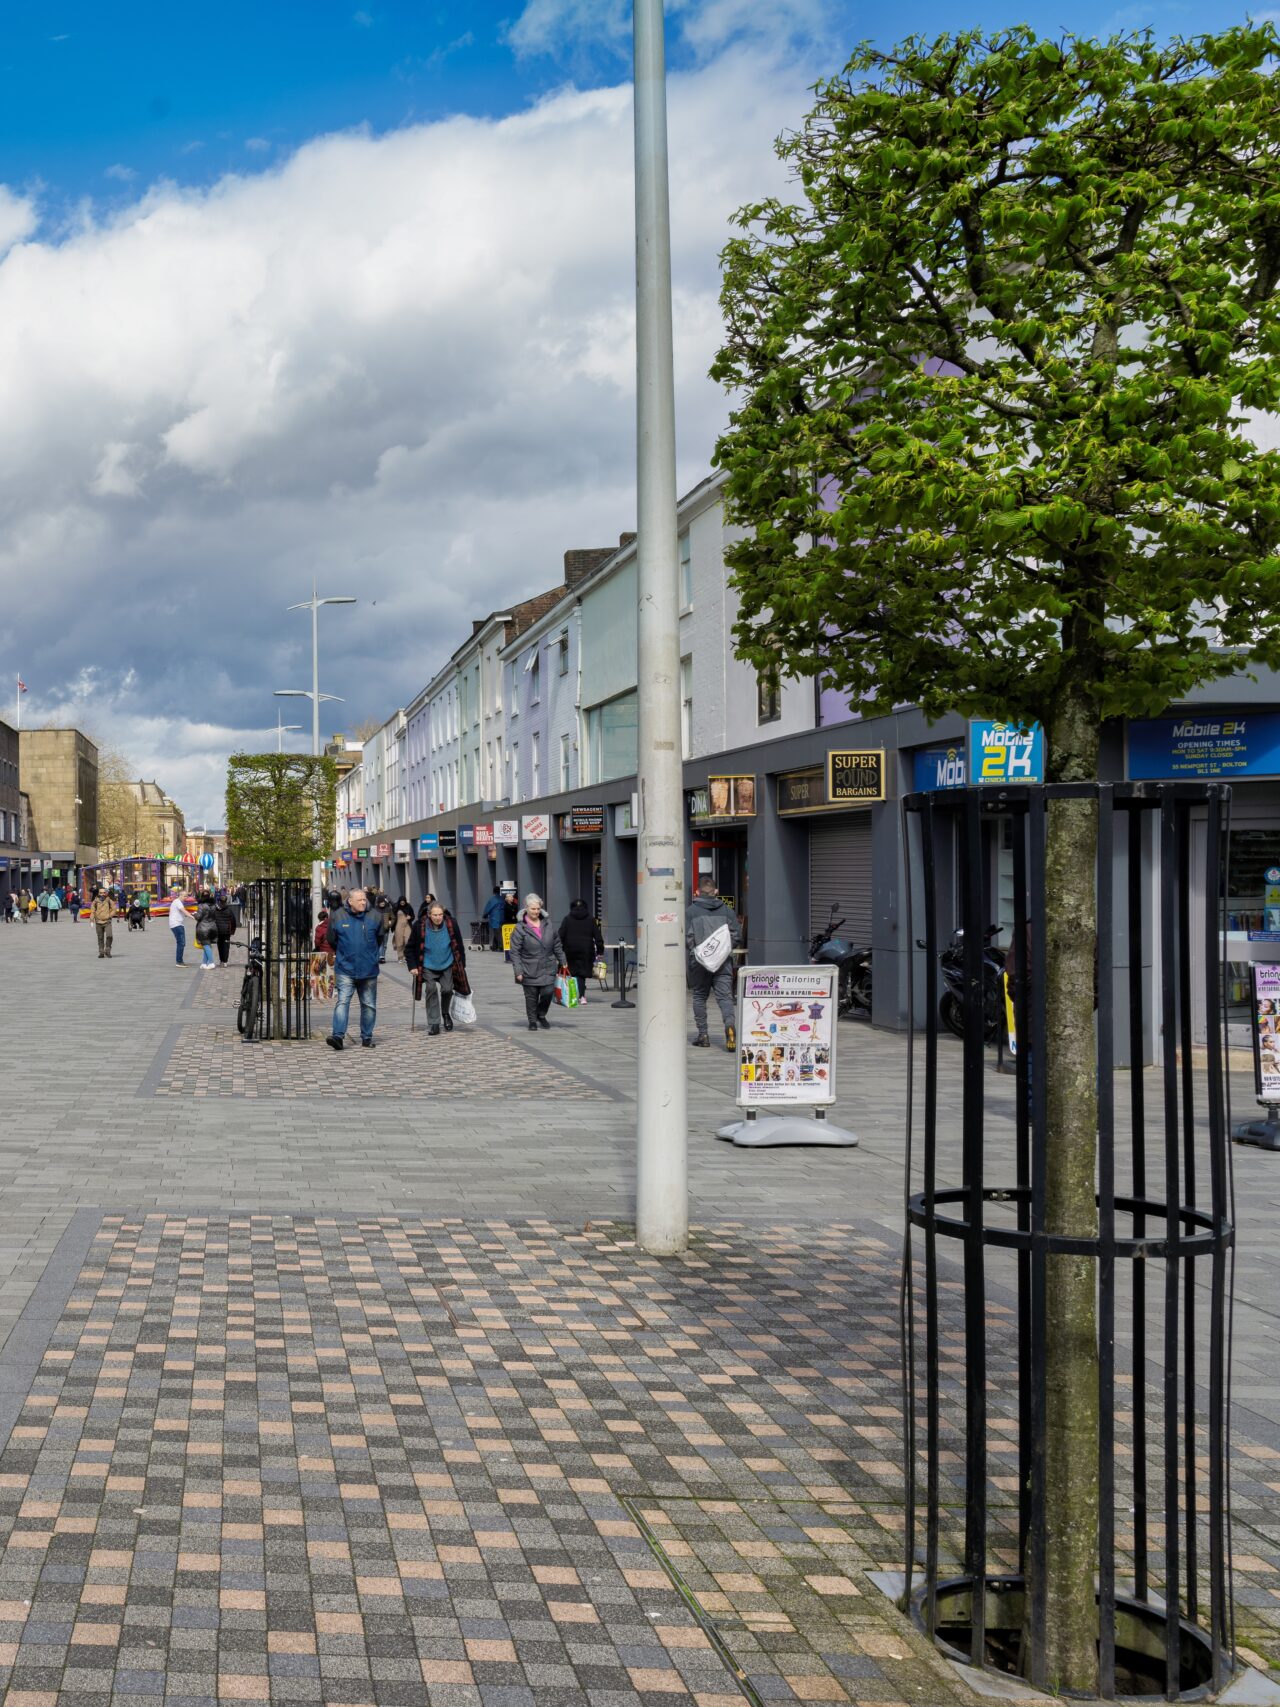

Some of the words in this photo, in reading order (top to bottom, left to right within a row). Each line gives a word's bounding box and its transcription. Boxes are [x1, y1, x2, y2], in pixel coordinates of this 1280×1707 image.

[1172, 723, 1220, 737] Mobile
[1222, 721, 1246, 735] 2K
[1177, 741, 1214, 749] OPENING
[1216, 739, 1241, 747] TIMES
[835, 755, 877, 769] SUPER
[981, 745, 1033, 776] 2K
[836, 768, 878, 787] POUND
[790, 783, 809, 800] SUPER
[836, 787, 878, 796] BARGAINS
[691, 794, 708, 814] DINA
[751, 975, 780, 988] triangle
[782, 975, 821, 985] Tailoring
